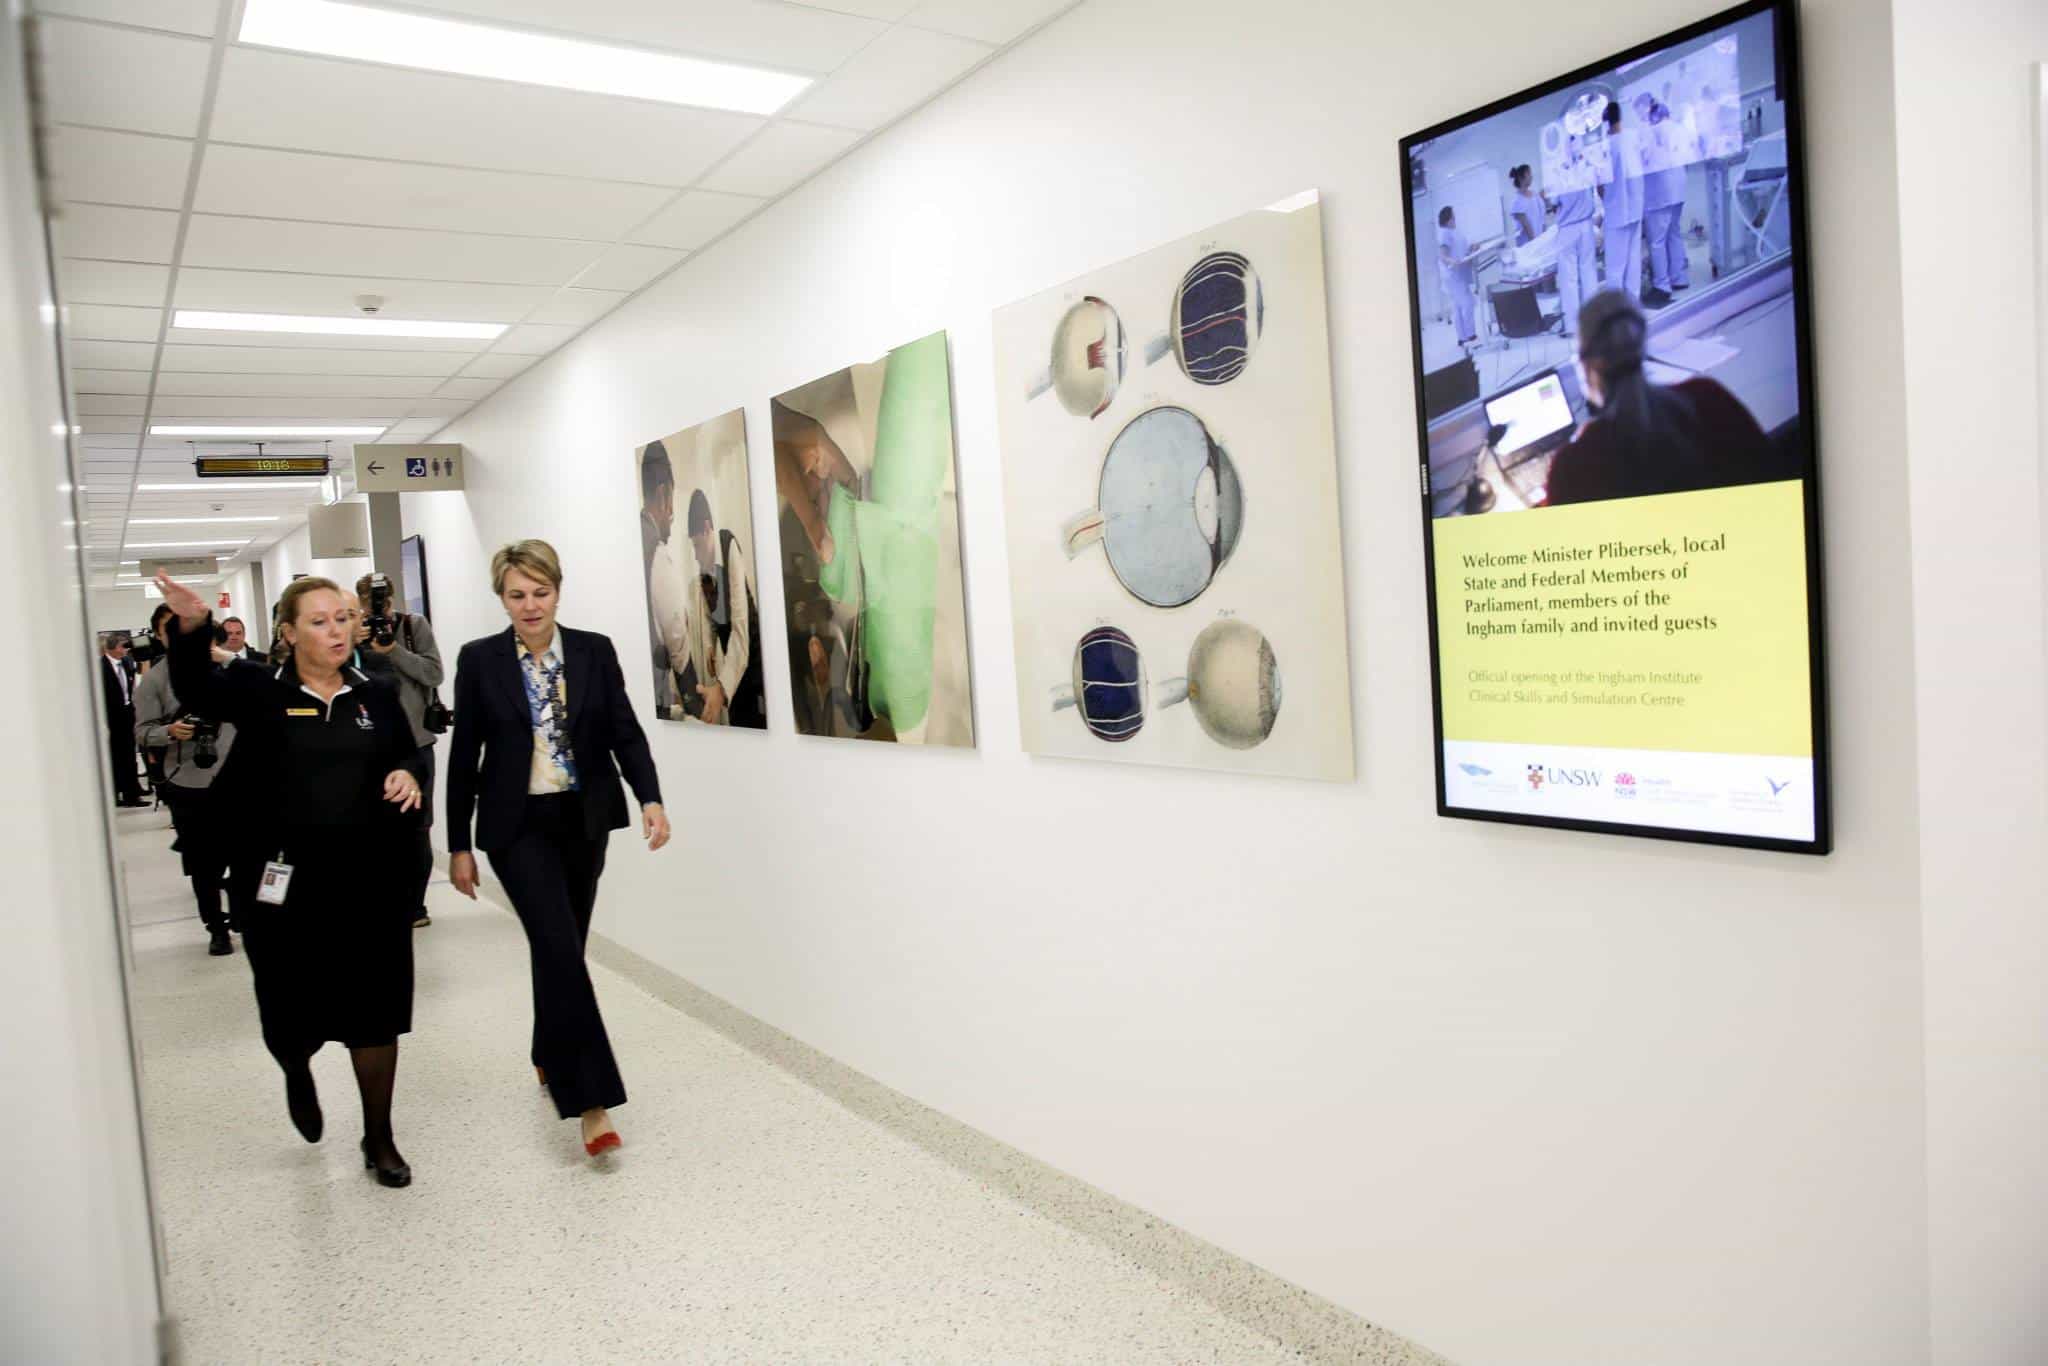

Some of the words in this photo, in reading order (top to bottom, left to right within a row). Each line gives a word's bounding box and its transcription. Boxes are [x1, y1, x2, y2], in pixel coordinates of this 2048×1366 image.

[1463, 552, 1527, 568] Welcome
[1533, 547, 1592, 563] Minister
[1599, 537, 1677, 559] Plibersek,
[1683, 533, 1725, 553] local
[1464, 577, 1496, 591] State
[1502, 572, 1527, 588] and
[1531, 570, 1585, 587] Federal
[1591, 565, 1665, 583] Members
[1671, 562, 1688, 579] of
[1465, 597, 1543, 613] Parliament,
[1548, 592, 1617, 609] members
[1623, 590, 1639, 606] of
[1645, 589, 1671, 605] the
[1467, 619, 1517, 640] Ingham
[1521, 617, 1565, 636] family
[1570, 616, 1598, 633] and
[1603, 614, 1658, 632] invited
[1664, 615, 1718, 636] guests
[1468, 670, 1508, 683] Official
[1512, 671, 1558, 686] opening
[1561, 670, 1574, 683] of
[1576, 670, 1595, 683] the
[1599, 670, 1646, 687] Ingham
[1649, 671, 1703, 684] Institute
[1469, 690, 1511, 703] Clinical
[1513, 690, 1543, 704] Skills
[1546, 691, 1568, 704] and
[1572, 691, 1636, 705] Simulation
[1641, 692, 1685, 706] Centre
[1548, 768, 1602, 787] UNSW
